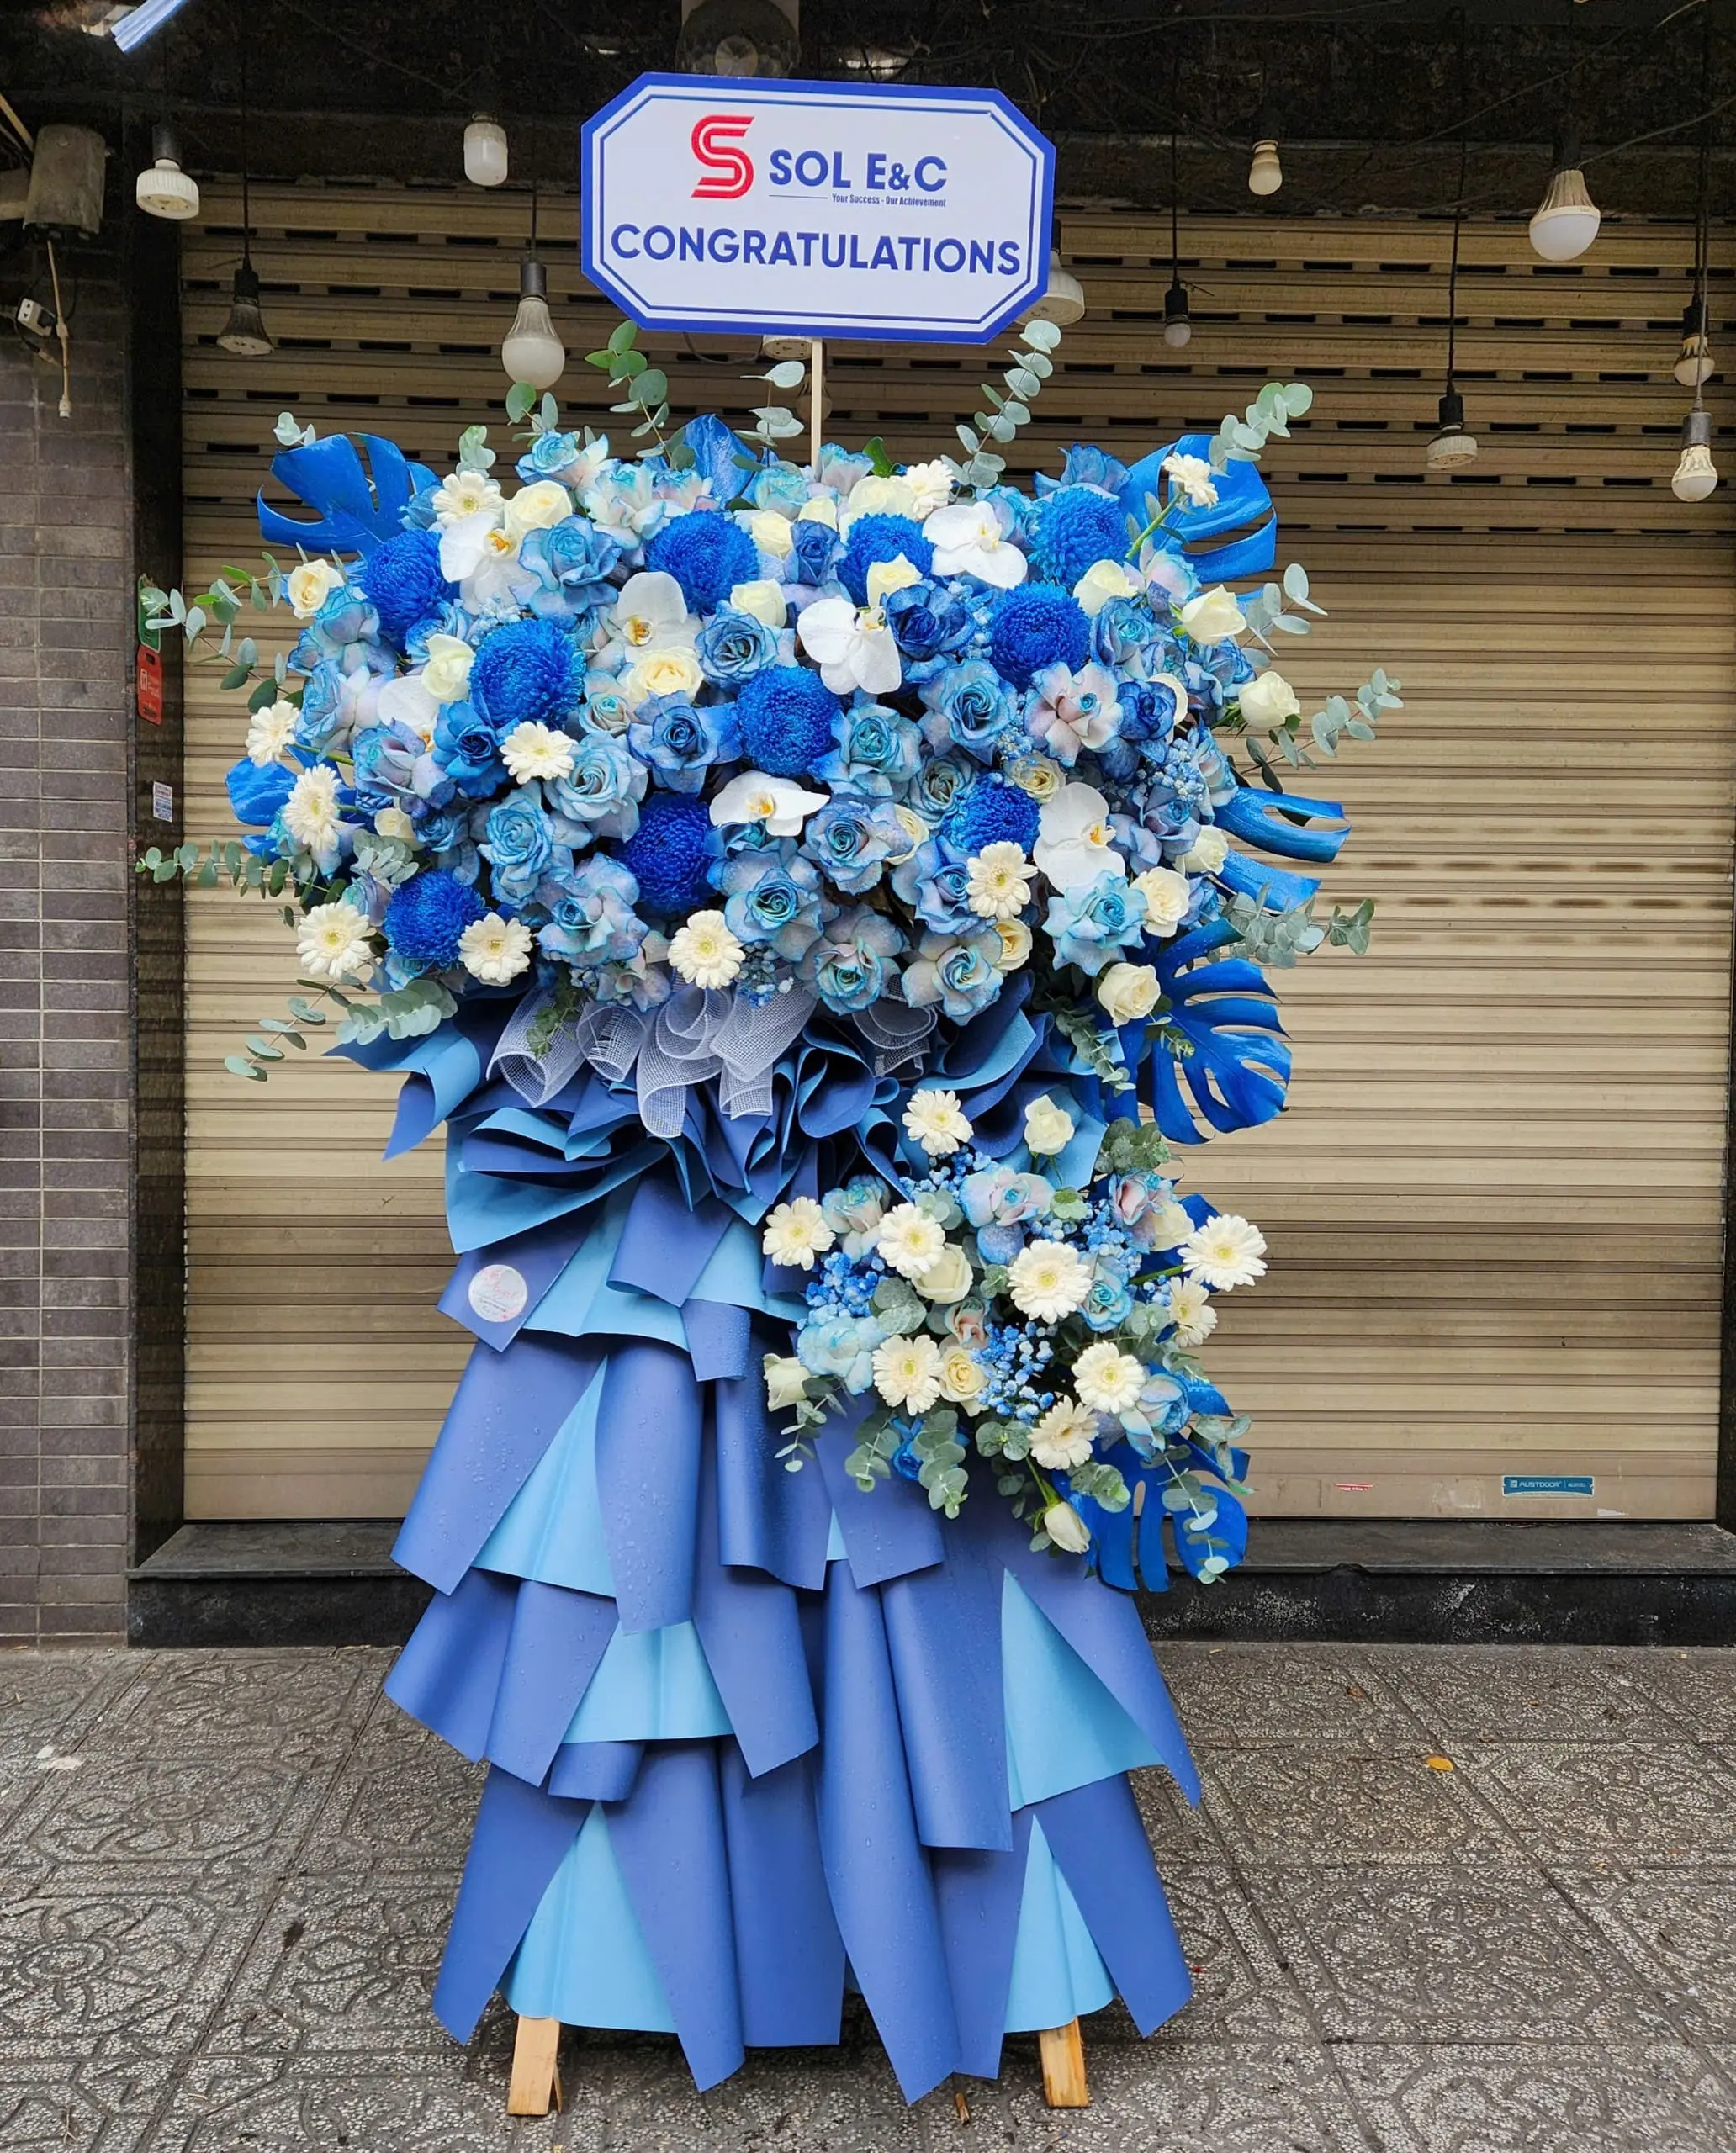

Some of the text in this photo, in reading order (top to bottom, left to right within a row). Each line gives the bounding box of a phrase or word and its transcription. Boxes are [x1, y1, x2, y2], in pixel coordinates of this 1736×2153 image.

[769, 148, 948, 193] SOL E&C
[832, 193, 848, 203] Your
[849, 193, 881, 205] Success
[886, 195, 897, 205] Our
[899, 196, 947, 208] Achievement
[611, 223, 1021, 276] CONGRATULATIONS
